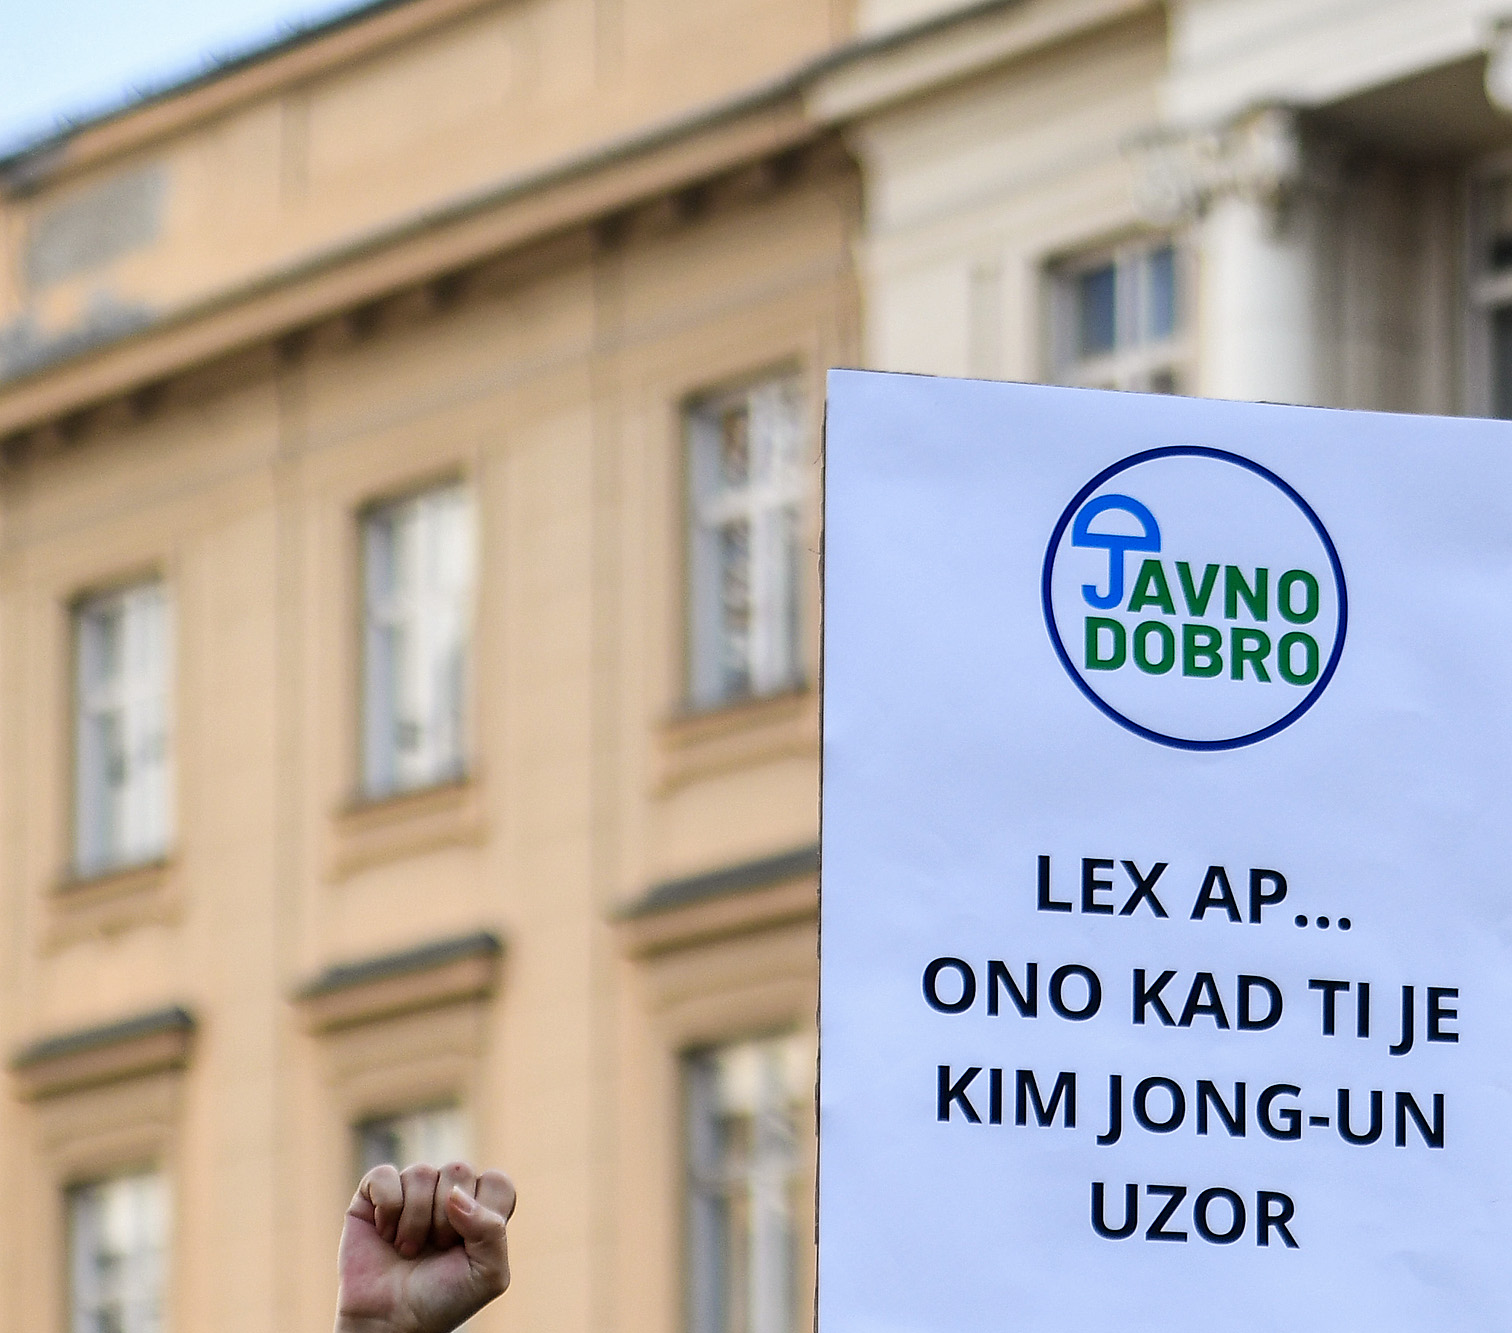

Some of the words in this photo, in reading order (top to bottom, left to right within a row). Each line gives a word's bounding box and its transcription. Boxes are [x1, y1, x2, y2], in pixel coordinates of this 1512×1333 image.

[1072, 515, 1320, 625] JAVNO
[1084, 616, 1320, 687] DOBRO
[1038, 855, 1169, 918] LEX
[1190, 866, 1351, 930] AP...
[923, 957, 1101, 1021] ONO
[1133, 969, 1283, 1030] KAD
[1309, 979, 1369, 1038] TI
[1389, 986, 1459, 1055] JE
[938, 1065, 1076, 1128] KIM
[1097, 1075, 1444, 1148] JONG-UN
[1092, 1182, 1299, 1248] UZOR
